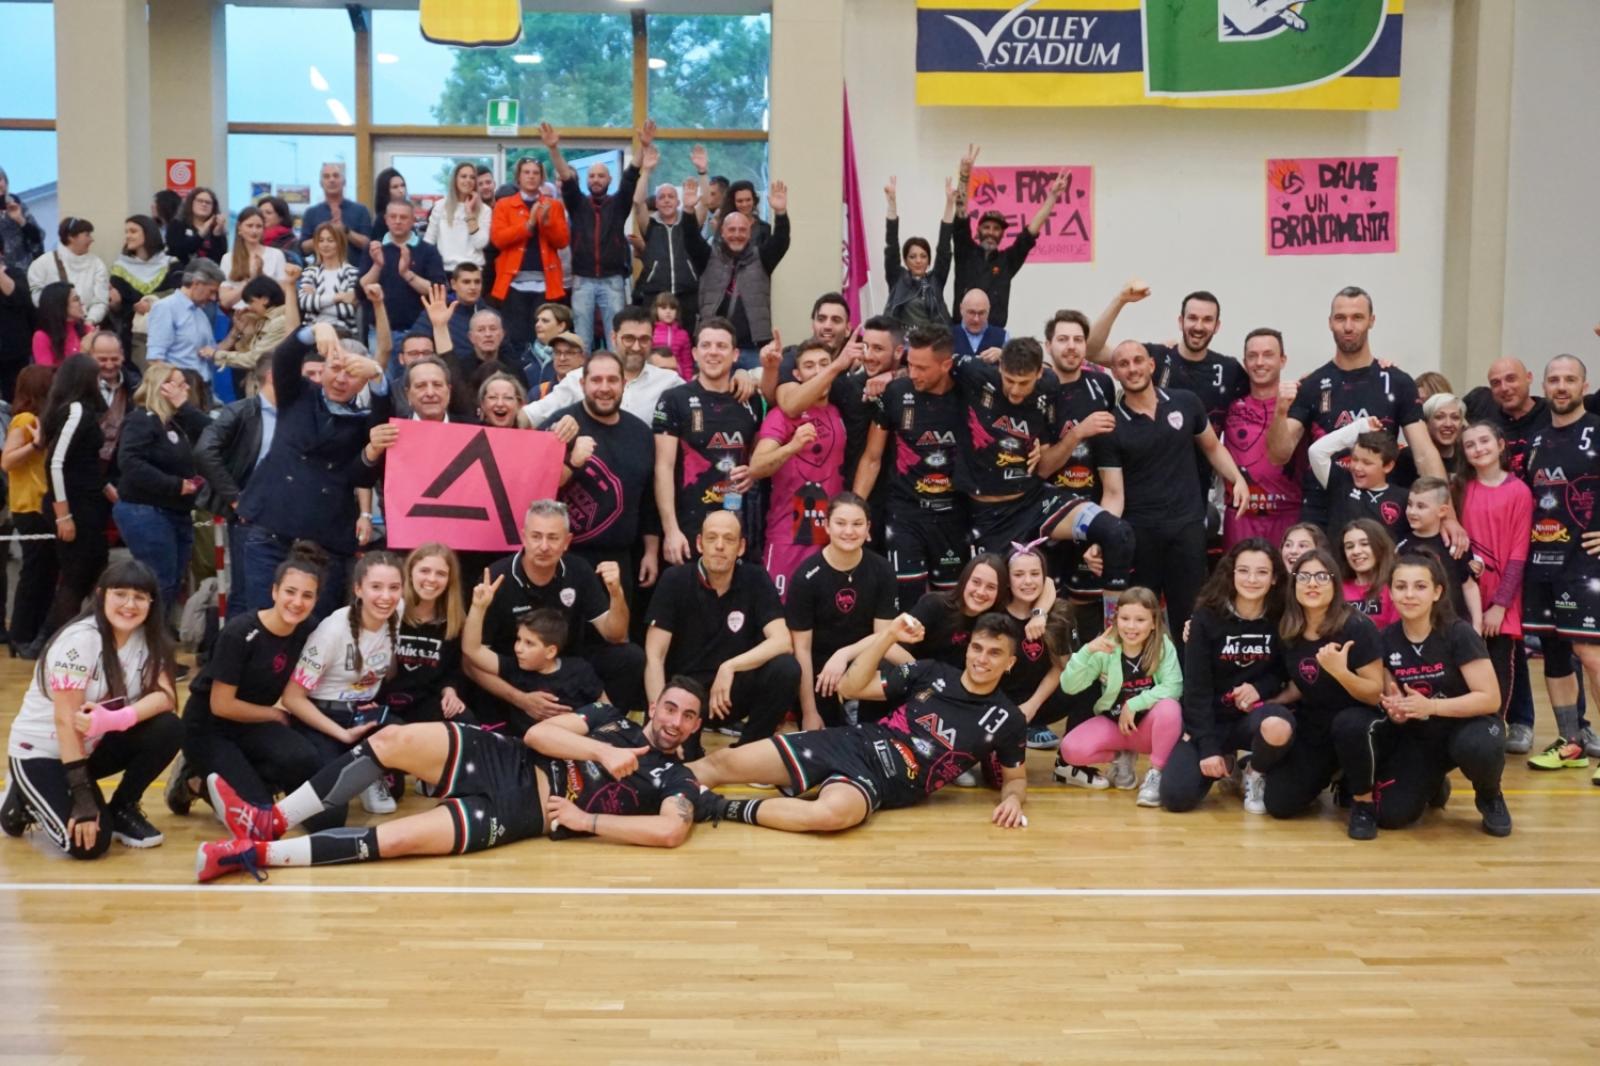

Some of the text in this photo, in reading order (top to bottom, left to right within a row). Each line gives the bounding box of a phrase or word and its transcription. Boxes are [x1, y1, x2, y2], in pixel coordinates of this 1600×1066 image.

[944, 0, 1098, 63] VOLLEY
[995, 42, 1120, 65] STADIUM
[1305, 192, 1328, 213] UN
[1212, 364, 1223, 386] 3
[1380, 371, 1390, 394] 7
[706, 431, 744, 449] AVA
[916, 431, 956, 446] AVA
[1578, 427, 1594, 450] 5
[775, 574, 786, 596] 9
[978, 705, 1009, 734] 13
